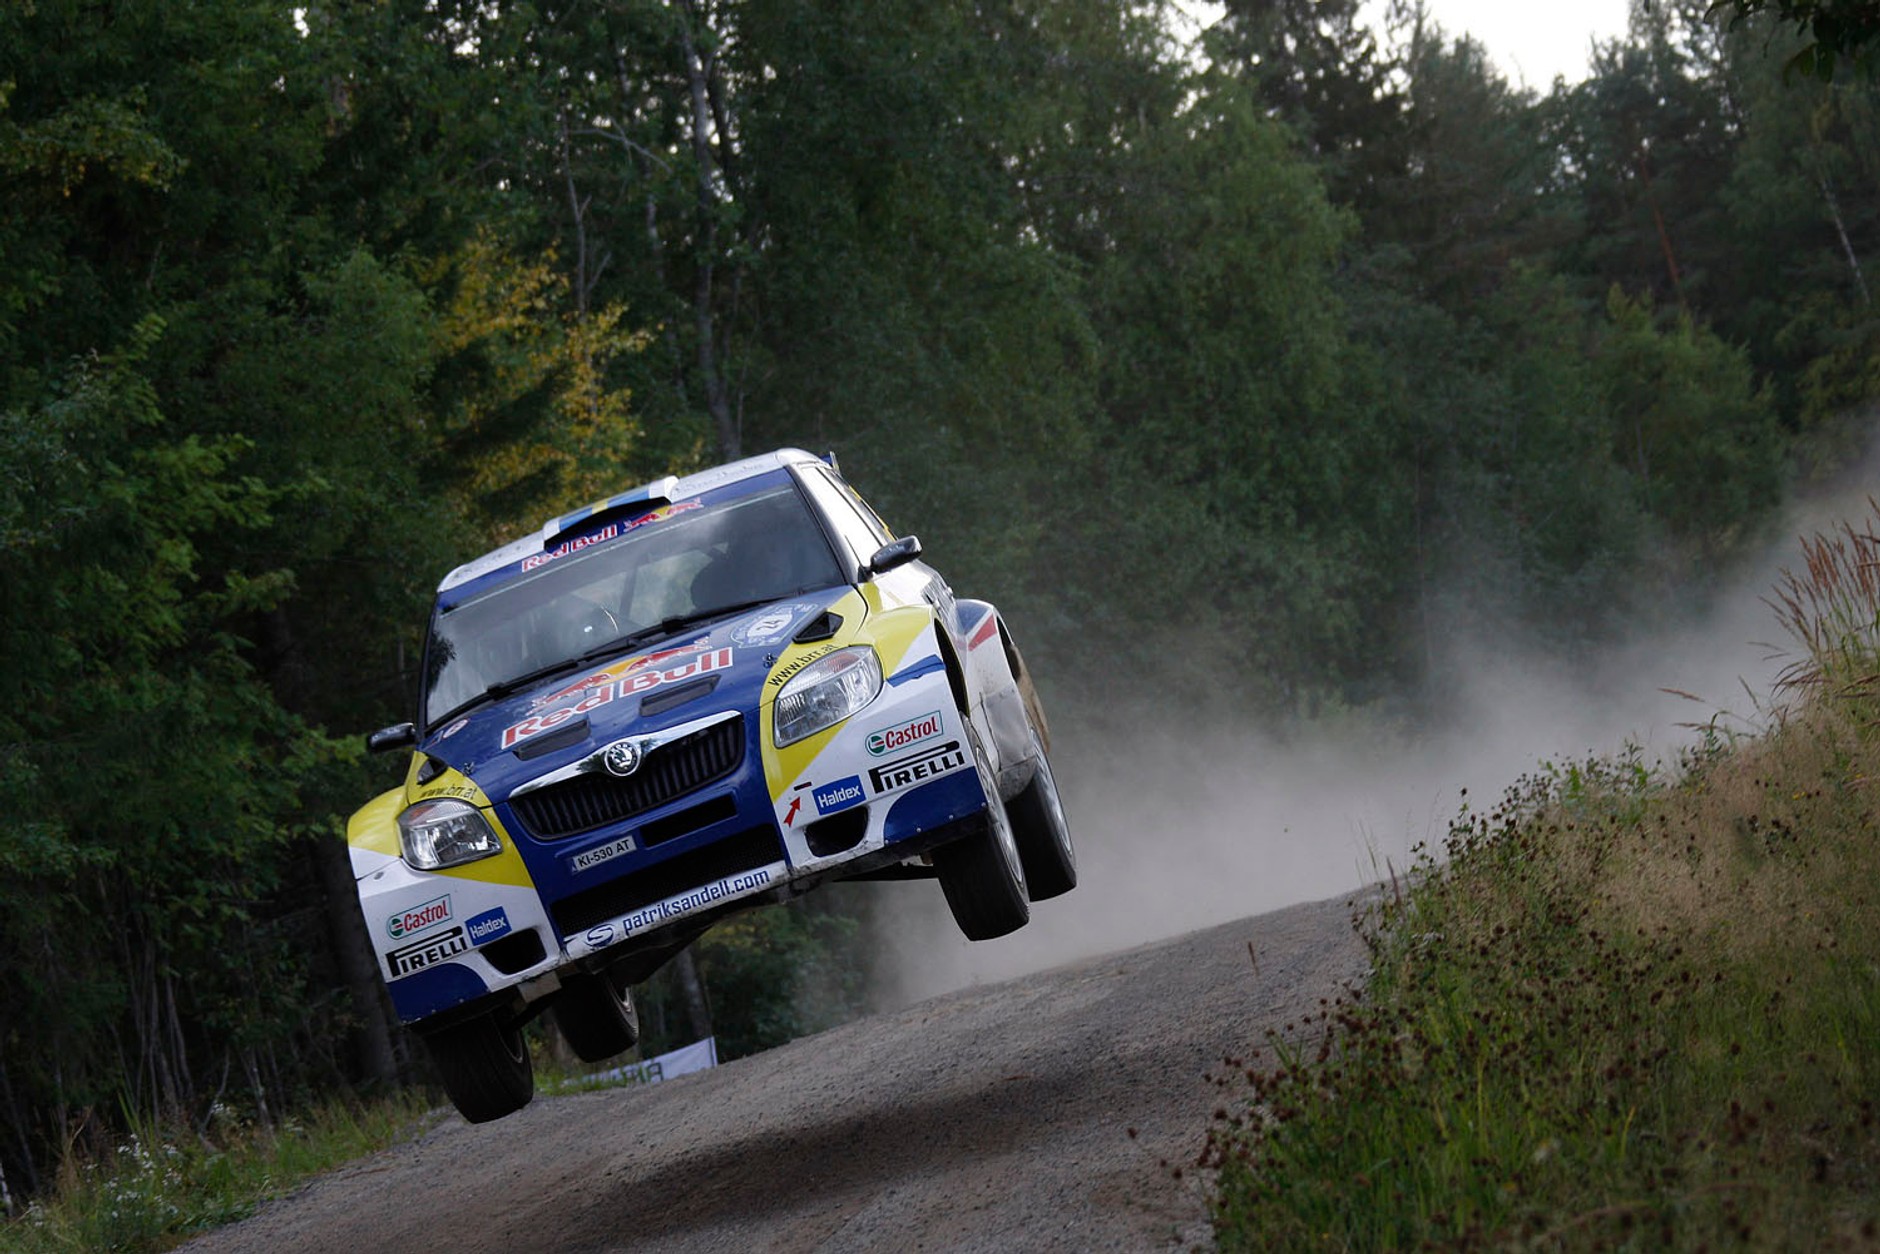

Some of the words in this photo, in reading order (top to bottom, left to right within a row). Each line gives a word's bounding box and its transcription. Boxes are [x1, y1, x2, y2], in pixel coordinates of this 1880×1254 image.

[522, 541, 568, 573] Red
[571, 524, 618, 552] Bull
[768, 643, 839, 687] www.brr.at
[501, 682, 614, 750] Red
[618, 647, 733, 698] Bull
[884, 716, 939, 750] Castrol
[868, 740, 965, 794] PIRELLI
[818, 784, 862, 809] Haldex
[616, 839, 630, 853] AT
[403, 899, 449, 932] Castrol
[622, 869, 771, 934] patriksandell.com
[471, 917, 508, 940] Haldex
[384, 926, 468, 977] PIRELLI
